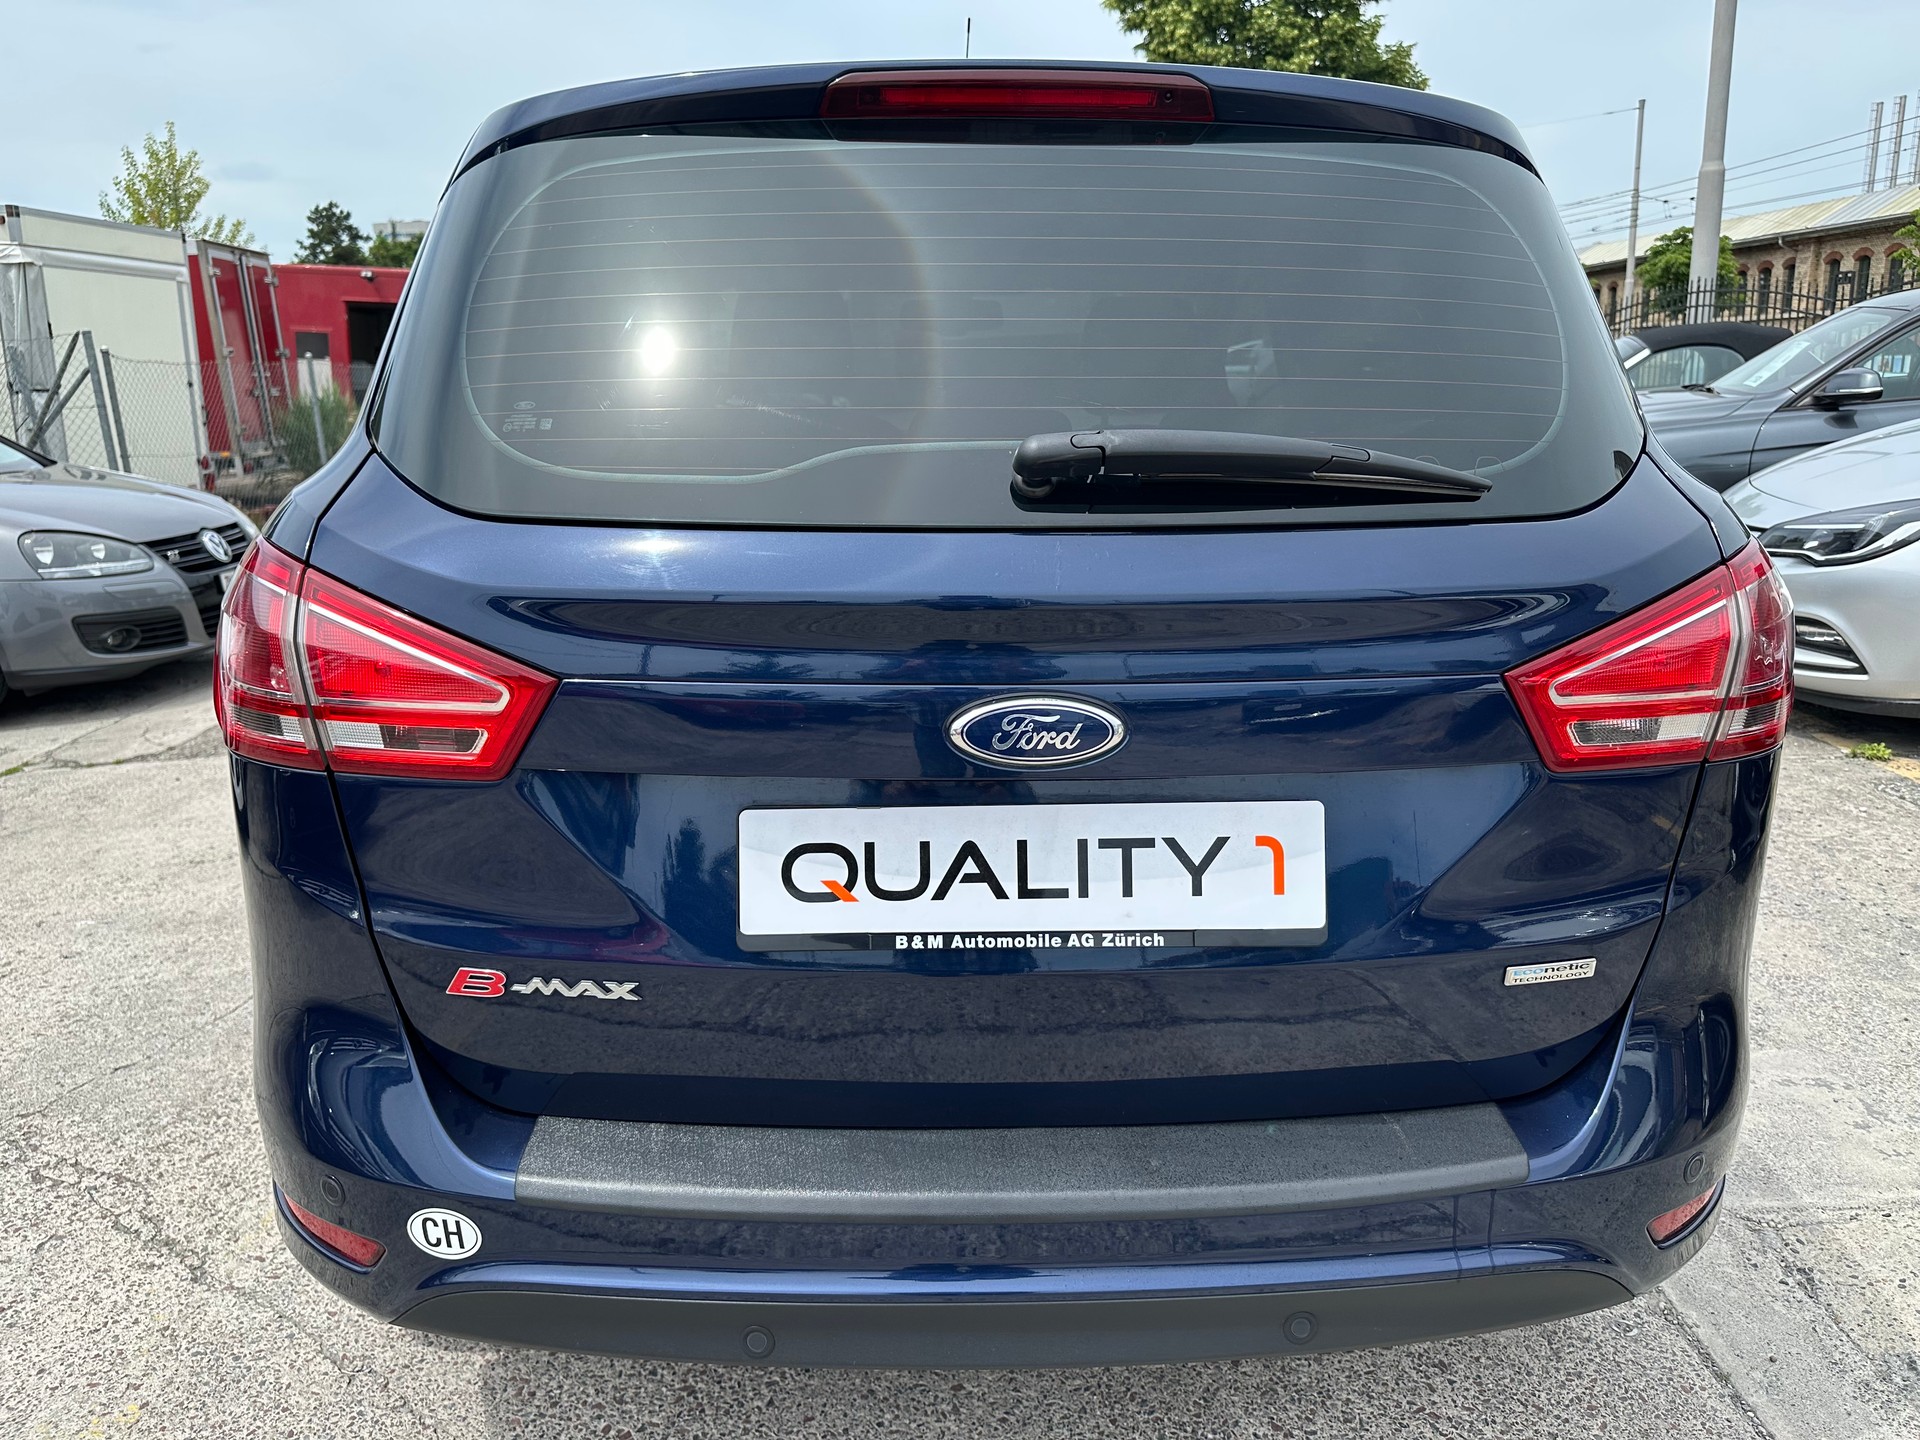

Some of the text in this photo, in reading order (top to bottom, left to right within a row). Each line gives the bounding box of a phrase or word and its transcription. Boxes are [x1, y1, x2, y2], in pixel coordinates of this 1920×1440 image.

[991, 713, 1083, 750] Ford
[781, 835, 1285, 902] QUALITY 1
[950, 933, 1062, 949] Automobile
[1067, 933, 1095, 947] AG
[1101, 932, 1165, 947] Zürich
[446, 967, 642, 1001] B-MAX
[1513, 970, 1590, 984] TECHNOLOGY
[421, 1217, 465, 1249] CH
